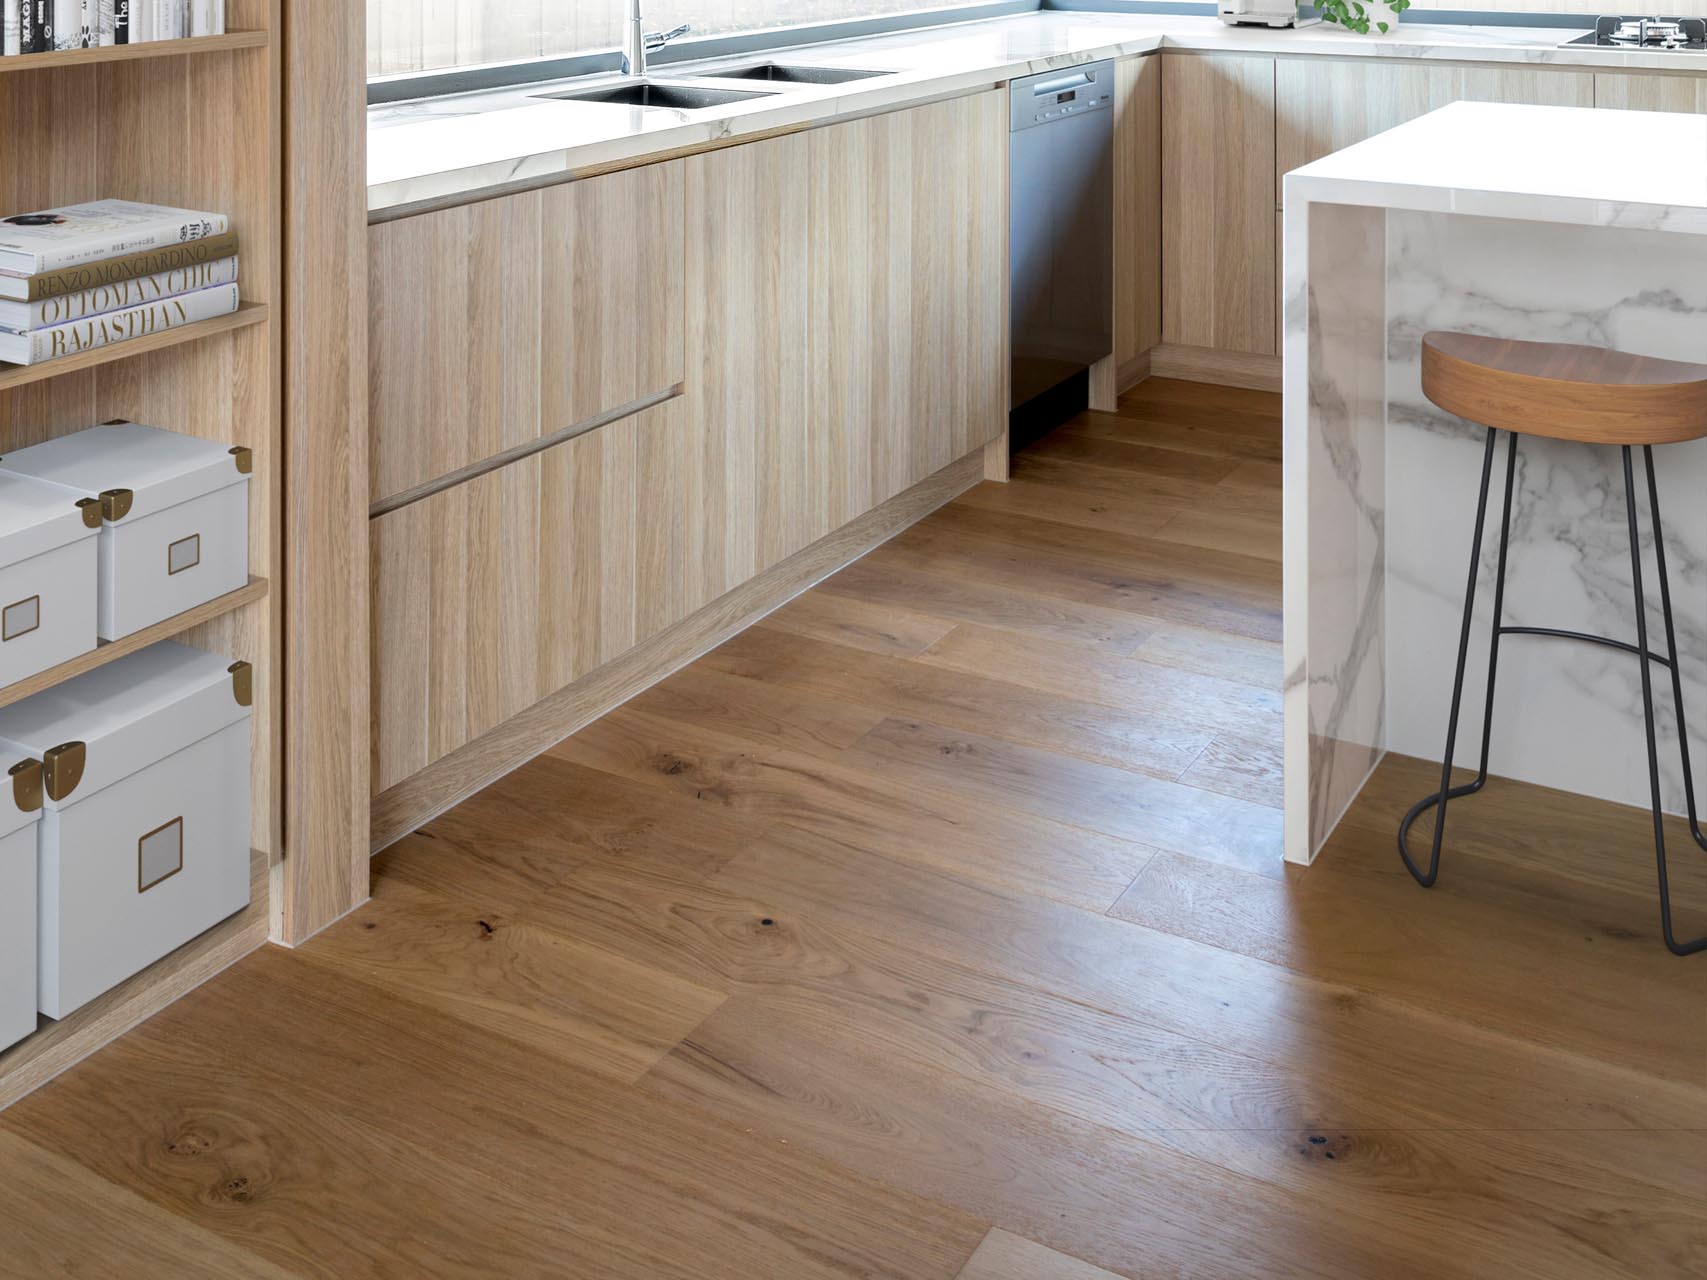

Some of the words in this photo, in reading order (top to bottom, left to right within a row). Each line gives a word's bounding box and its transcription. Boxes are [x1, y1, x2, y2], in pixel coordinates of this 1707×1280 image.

[115, 2, 128, 29] The
[37, 269, 91, 297] RENZO
[95, 244, 208, 285] MONGIARDINO
[41, 277, 163, 325] OTTOMAN
[167, 262, 220, 295] CHIC
[51, 301, 188, 357] RAJASTHAN
